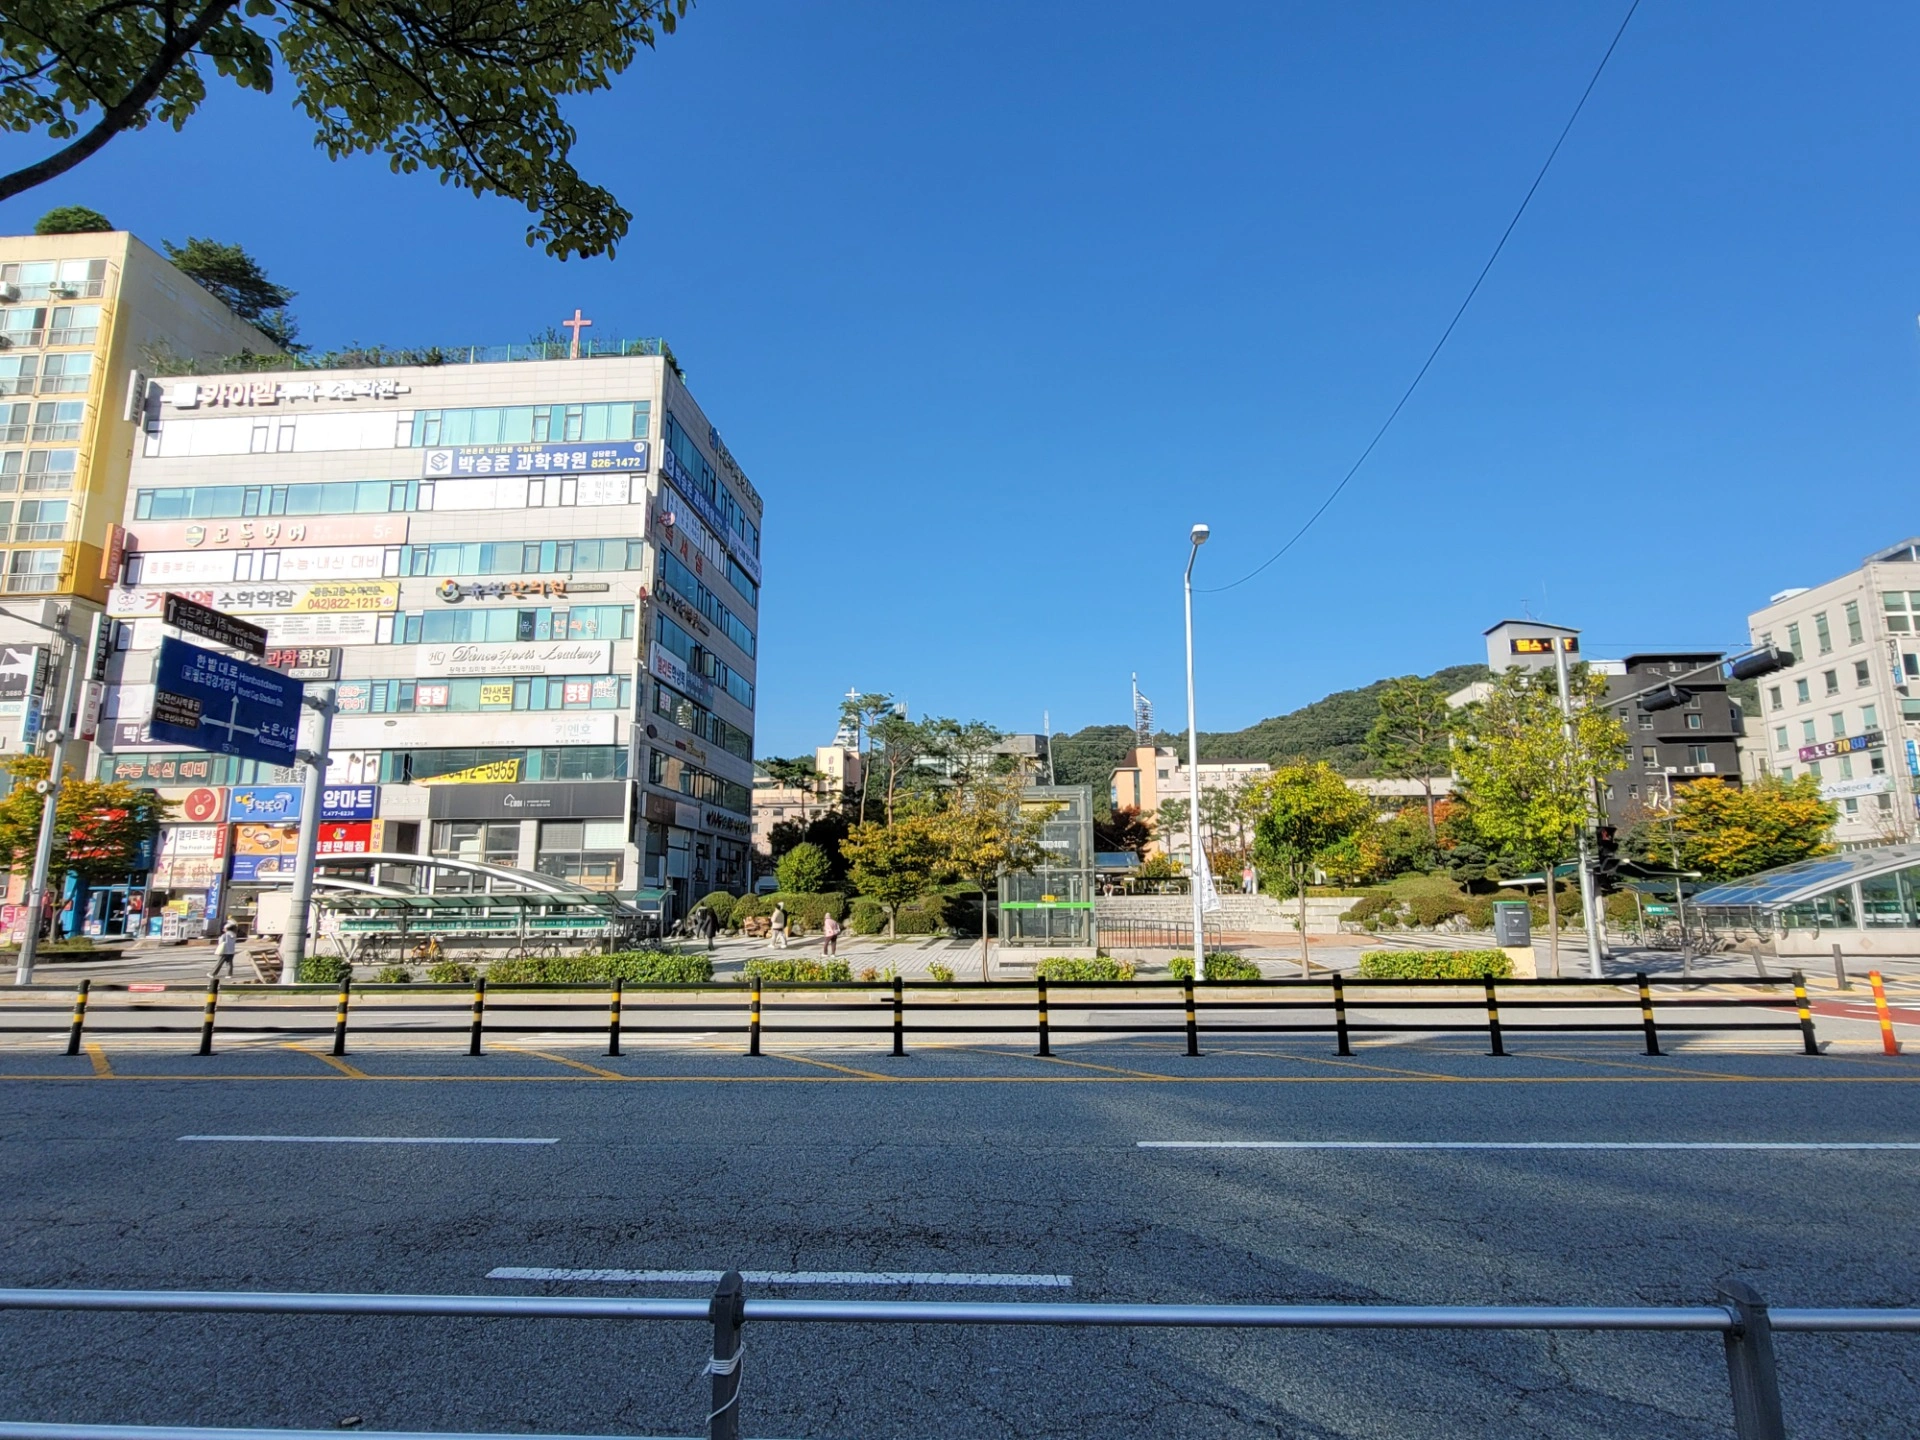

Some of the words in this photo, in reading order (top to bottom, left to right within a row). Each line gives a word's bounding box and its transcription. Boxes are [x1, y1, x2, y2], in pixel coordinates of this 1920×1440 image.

[458, 455, 510, 473] 박승준
[516, 452, 587, 471] 과학학원
[591, 458, 641, 468] 826-1472
[213, 519, 306, 547] 고등영어
[351, 555, 379, 569] 대비
[217, 587, 297, 608] 수학학원
[308, 597, 382, 610] 042)822-1215
[196, 654, 239, 679] 한밭대로
[266, 648, 332, 668] 과학학원
[418, 687, 447, 705] 명찰
[482, 685, 512, 703] 학생복
[565, 684, 591, 702] 명찰
[261, 721, 297, 741] 노은서길
[115, 762, 144, 779] 수능
[148, 761, 176, 778] 내신
[179, 760, 208, 778] 대비
